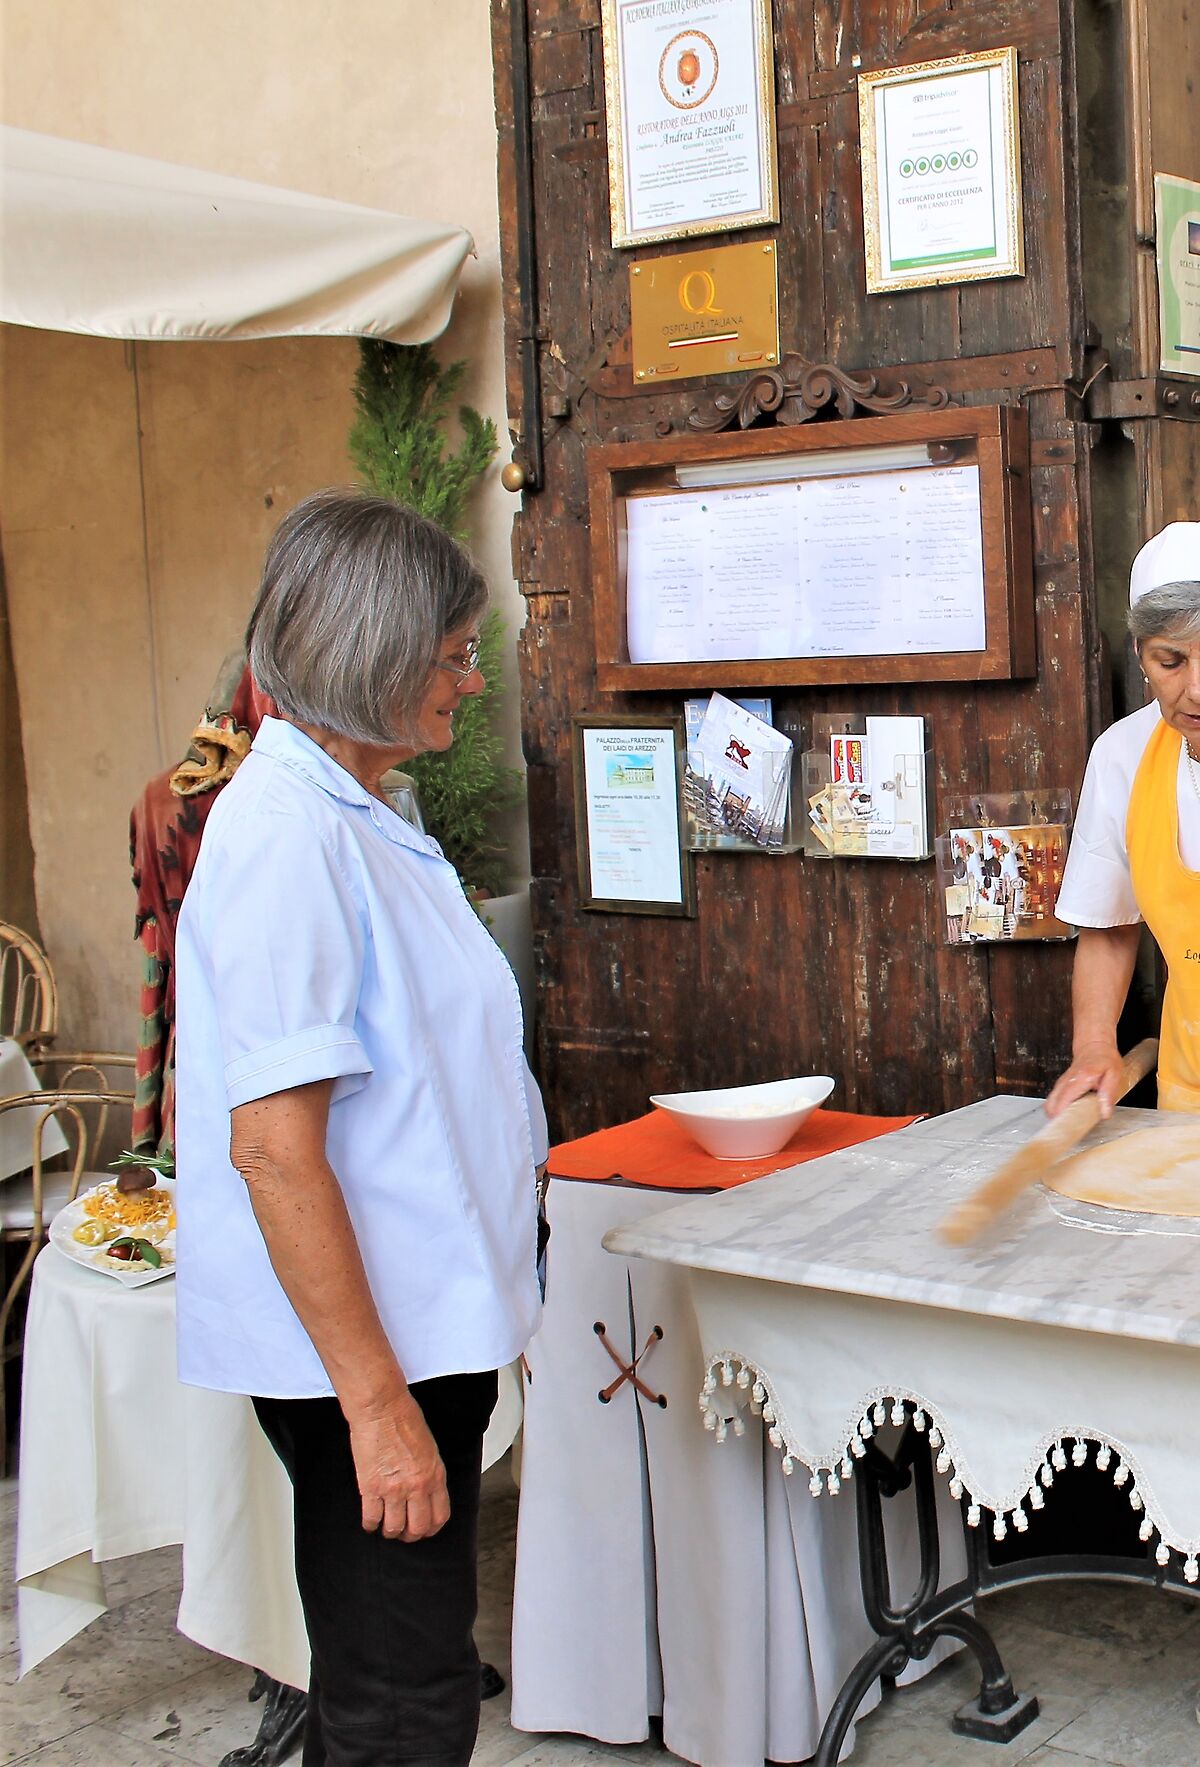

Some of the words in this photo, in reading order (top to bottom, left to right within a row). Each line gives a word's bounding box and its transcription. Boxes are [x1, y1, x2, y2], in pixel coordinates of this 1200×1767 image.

[661, 128, 692, 146] Andrea
[696, 119, 735, 139] Fazzuoli
[898, 193, 935, 205] CERTIFICATO
[937, 192, 944, 200] DI
[945, 187, 983, 198] ECCELLENZA
[950, 198, 963, 206] 2012
[679, 270, 724, 316] Q
[707, 315, 744, 329] ITALIANA
